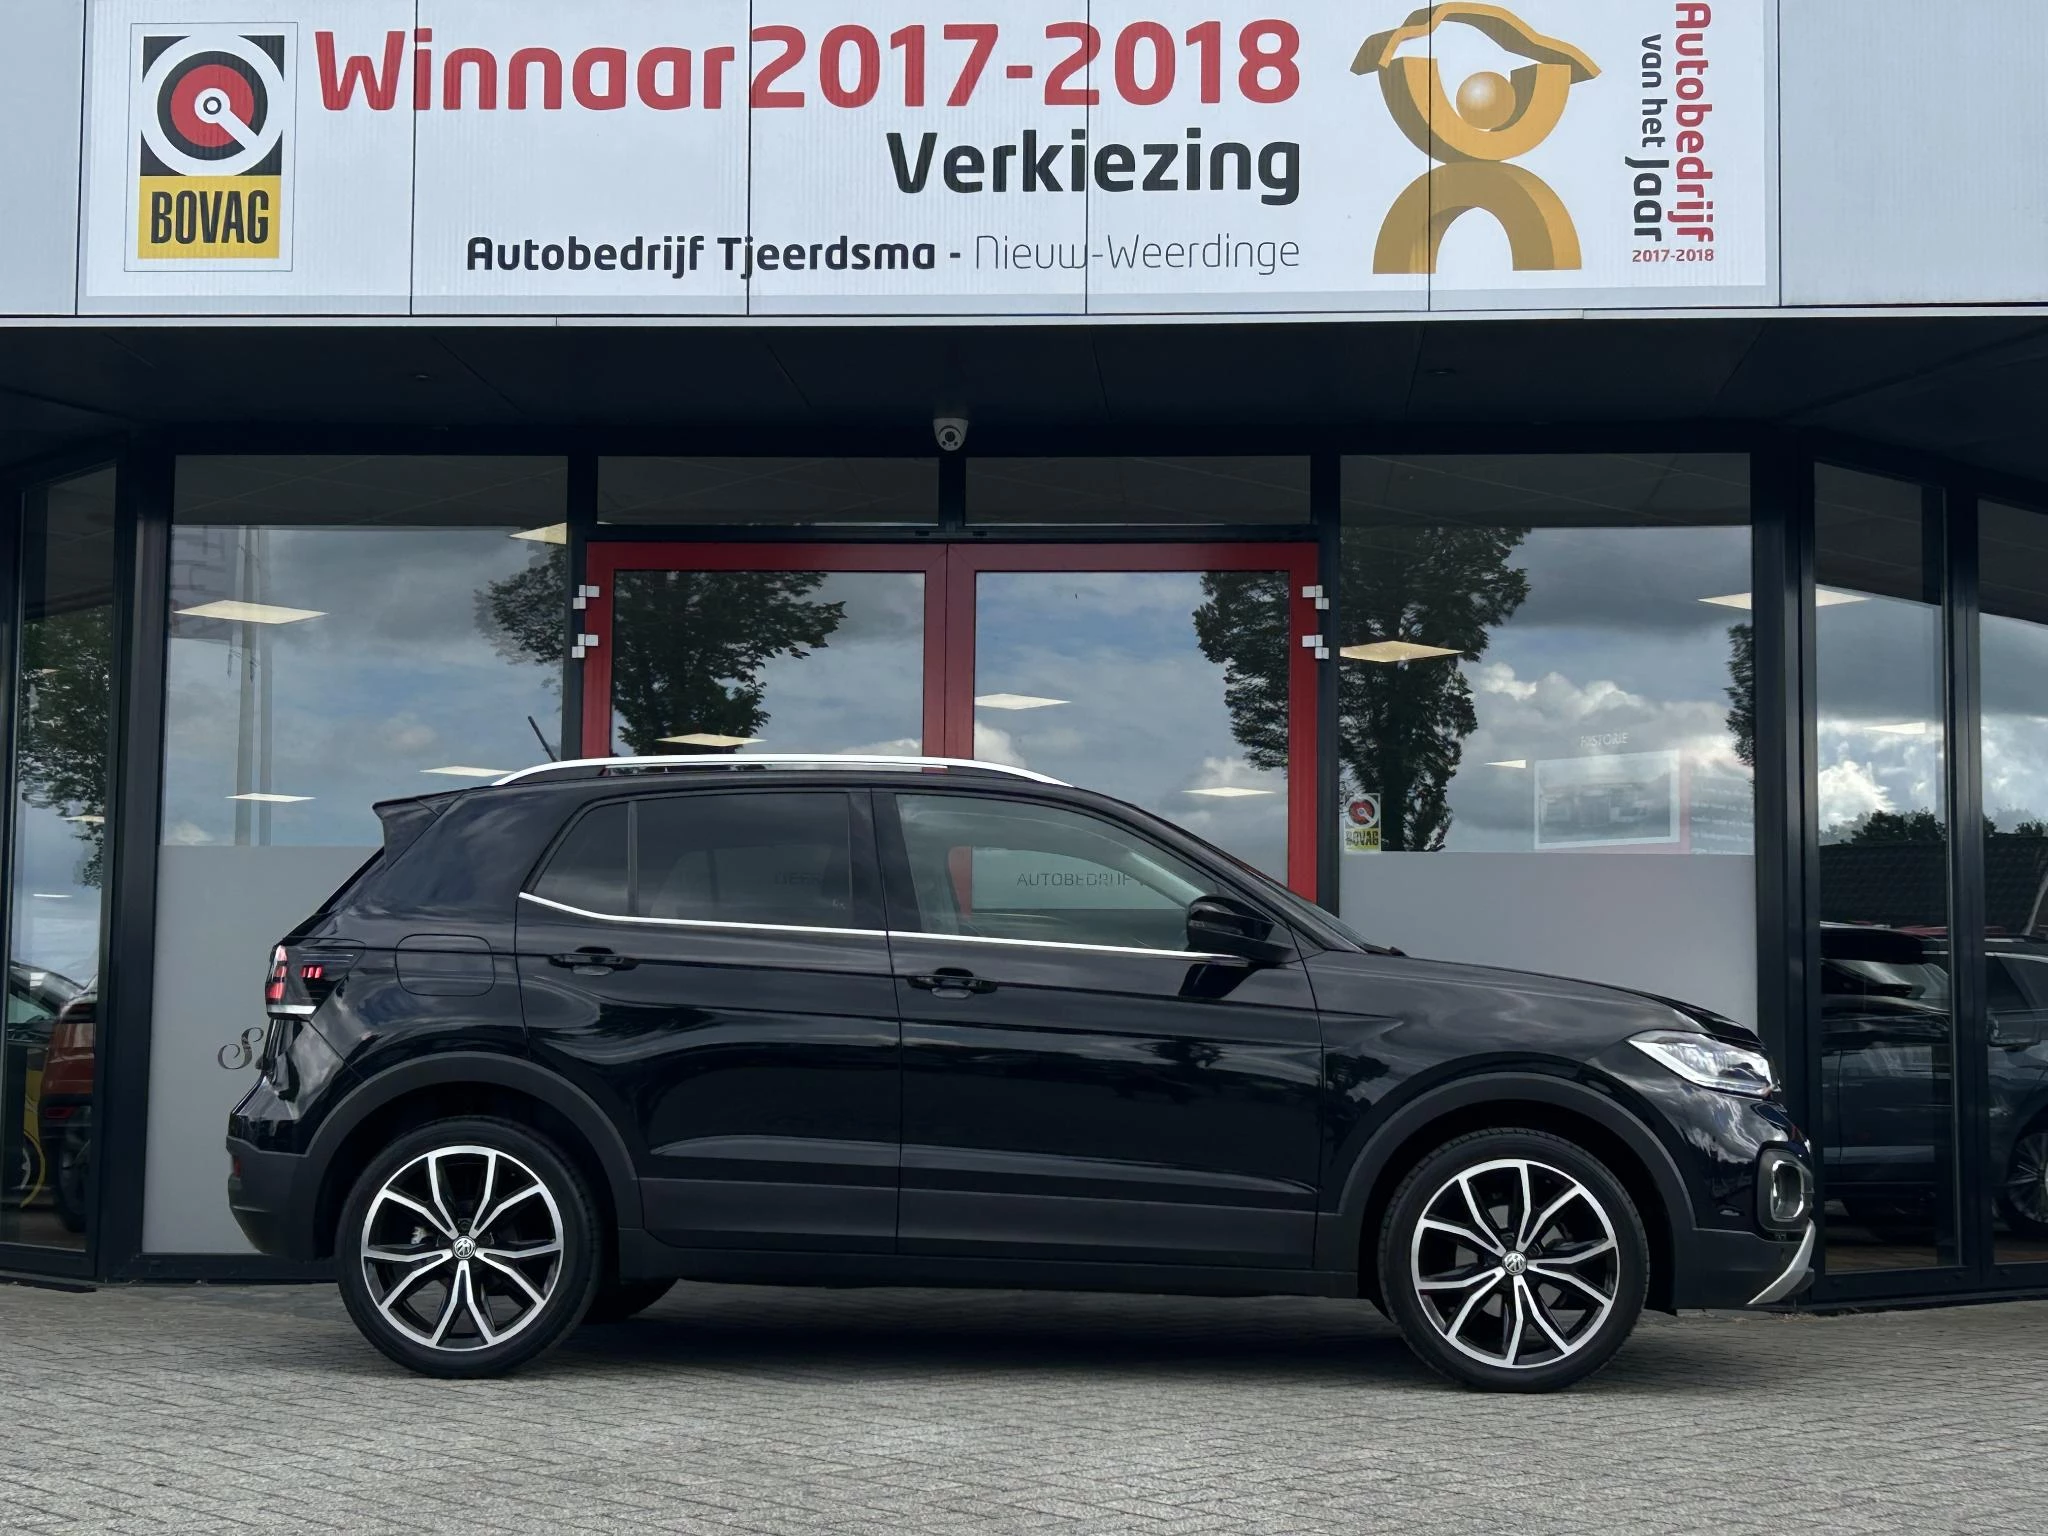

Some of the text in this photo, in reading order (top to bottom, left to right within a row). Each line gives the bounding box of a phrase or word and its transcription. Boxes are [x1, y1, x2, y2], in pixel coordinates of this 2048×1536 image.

[316, 19, 1300, 111] Winnaar 2017-2018
[1624, 33, 1670, 242] van het Jaar
[1668, 2, 1714, 242] Autobedrijf
[886, 127, 1300, 206] Verkiezing
[150, 189, 270, 246] BOVAG
[467, 235, 705, 280] Autobedrijf
[717, 235, 935, 280] Tjeerdsma
[976, 232, 1300, 276] Nieuw-Weerdinge
[1632, 249, 1714, 263] 2017-2018
[1345, 830, 1379, 846] BOVAG
